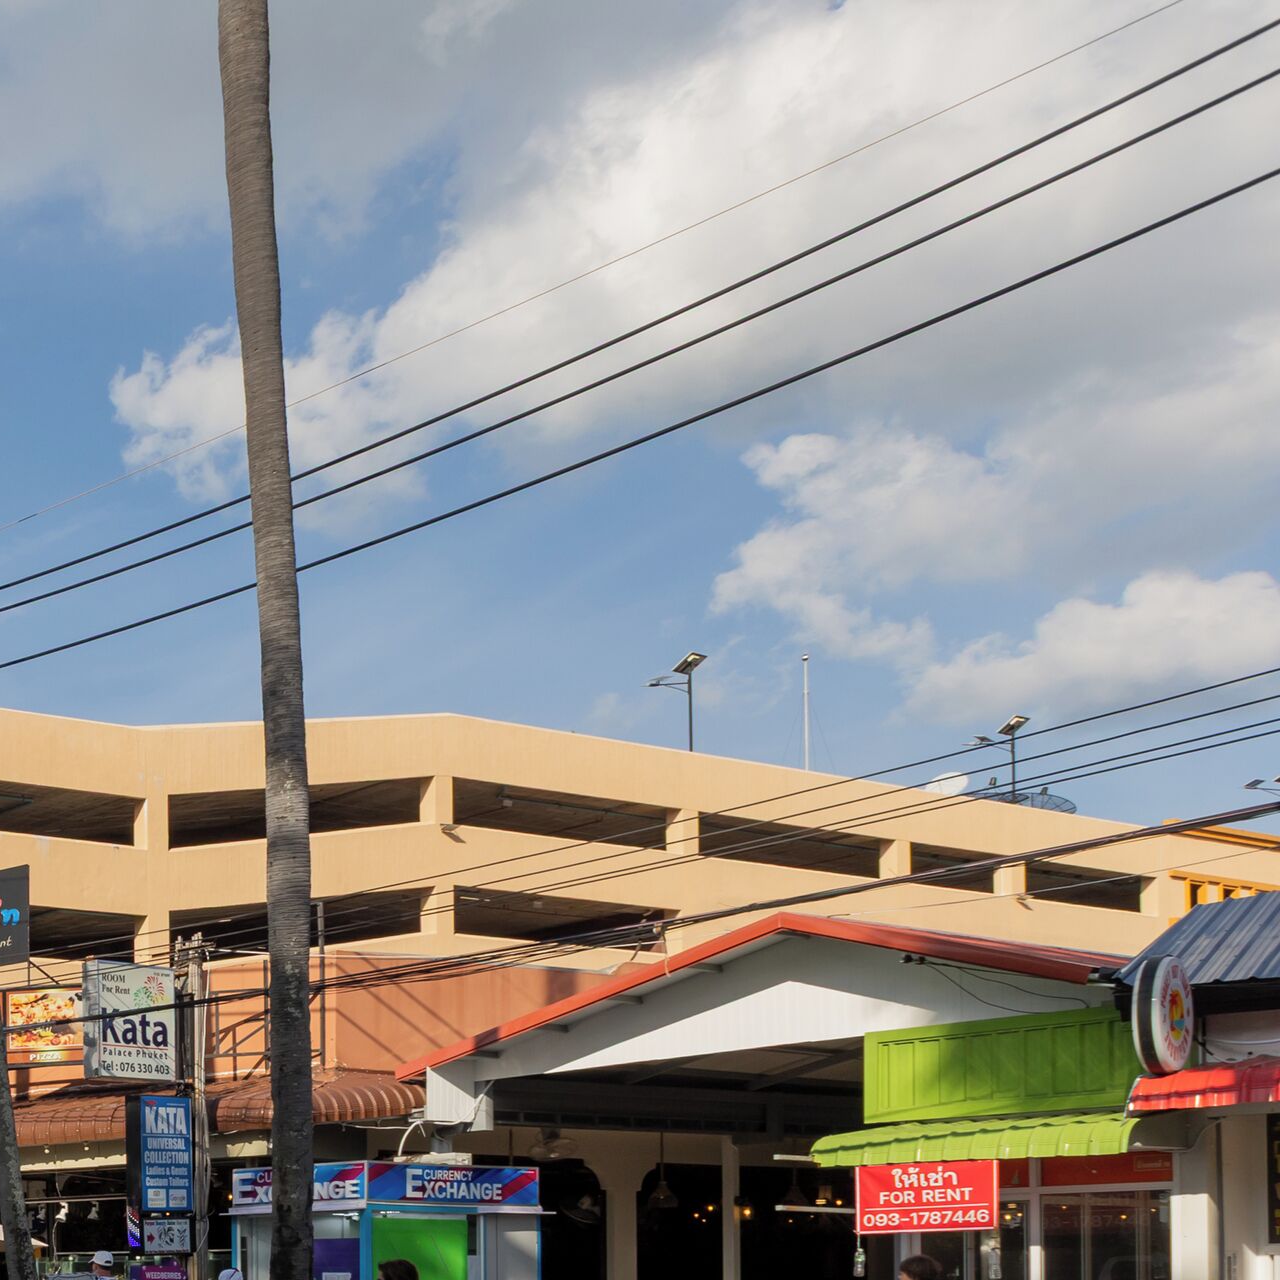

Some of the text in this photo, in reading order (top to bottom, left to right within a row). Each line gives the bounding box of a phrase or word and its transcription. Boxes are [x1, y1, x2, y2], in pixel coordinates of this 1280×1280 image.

[101, 973, 125, 983] ROOM
[101, 984, 130, 995] For Rent
[101, 1007, 168, 1047] Kata
[29, 1053, 61, 1061] PIZZA
[103, 1047, 168, 1060] Palace Phuket
[120, 1062, 135, 1072] 076
[137, 1063, 153, 1074] 330
[155, 1065, 170, 1075] 403
[145, 1106, 187, 1134] KATA
[147, 1137, 186, 1150] UNIVERSAL
[144, 1151, 189, 1164] COLLECTION
[423, 1169, 472, 1181] CURRENCY
[891, 1166, 958, 1188] ให้เช่า
[406, 1169, 503, 1201] EXCHANGE
[879, 1187, 973, 1204] FOR RENT
[863, 1209, 989, 1227] 093-1787446
